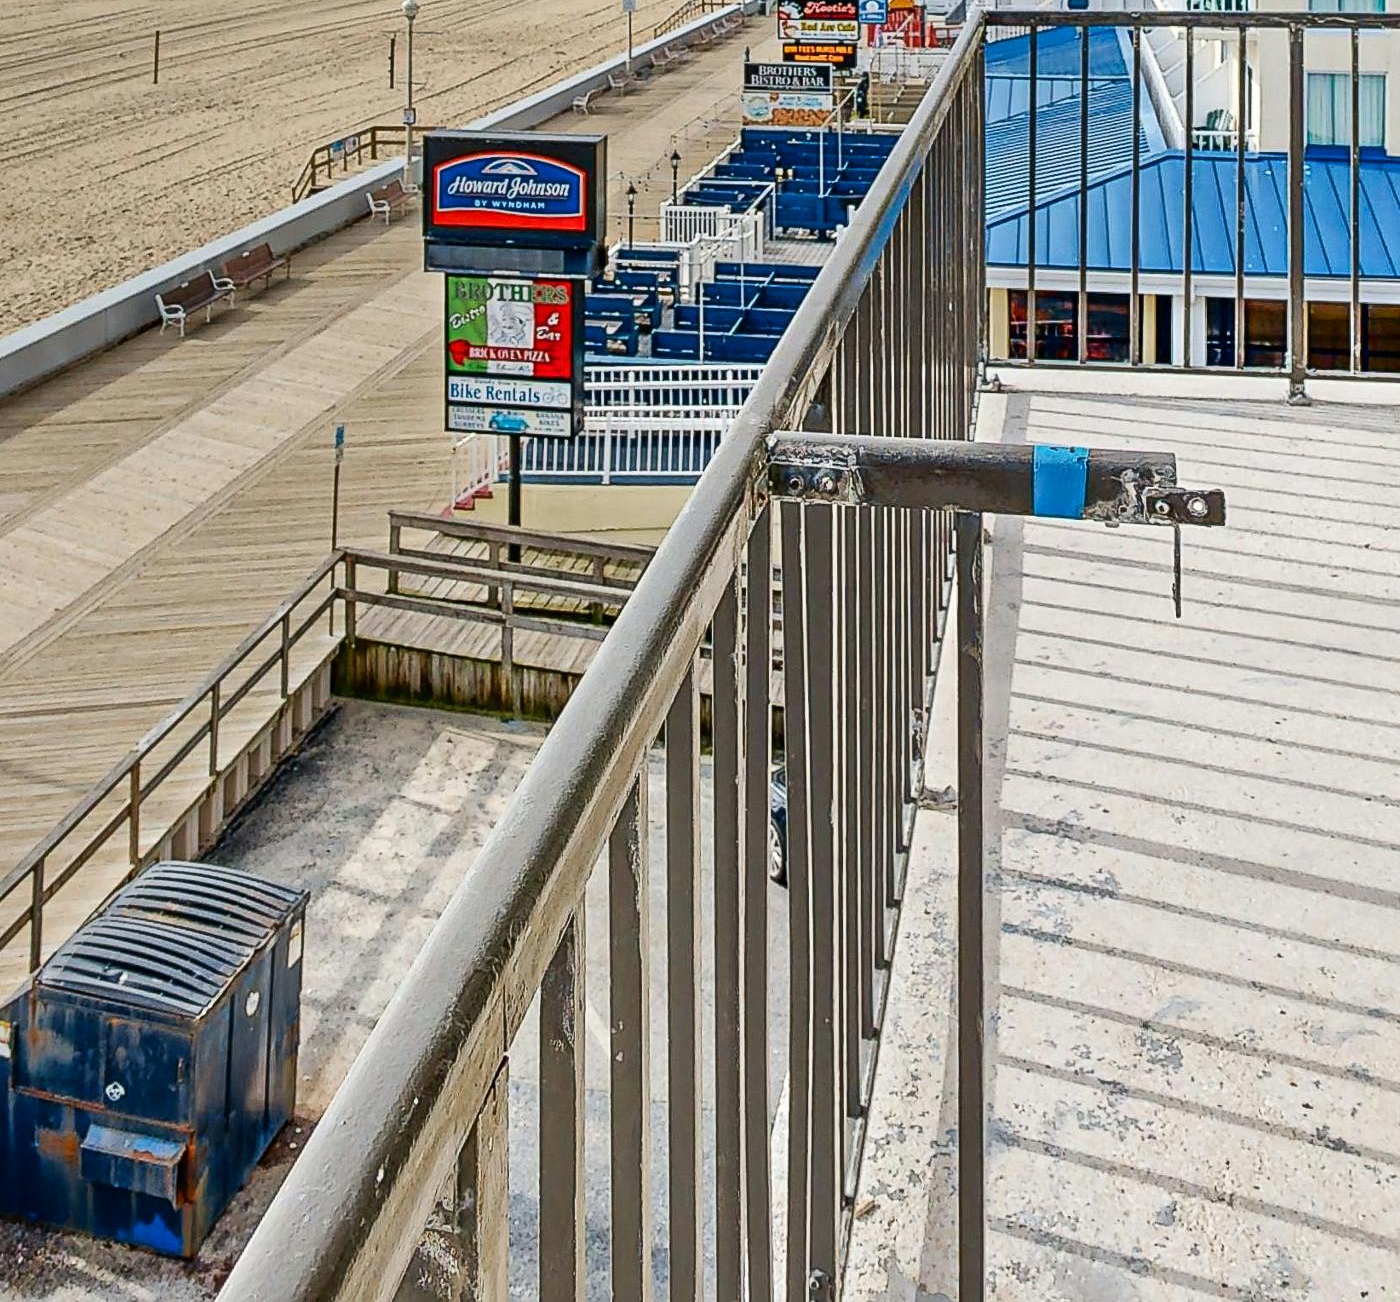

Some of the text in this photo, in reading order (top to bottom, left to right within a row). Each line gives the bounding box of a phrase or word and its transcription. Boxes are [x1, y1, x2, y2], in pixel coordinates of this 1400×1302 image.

[758, 65, 817, 76] BROTHERS
[751, 74, 825, 86] BISTRO & BAR
[447, 176, 569, 199] Howard Johnson
[474, 199, 545, 209] BY WYNDHAM
[455, 281, 569, 305] BROTHERS
[547, 312, 560, 326] &
[536, 326, 561, 341] Bar
[469, 347, 550, 362] BRICK OVEN PIZZA
[450, 383, 541, 403] Bike Rentals
